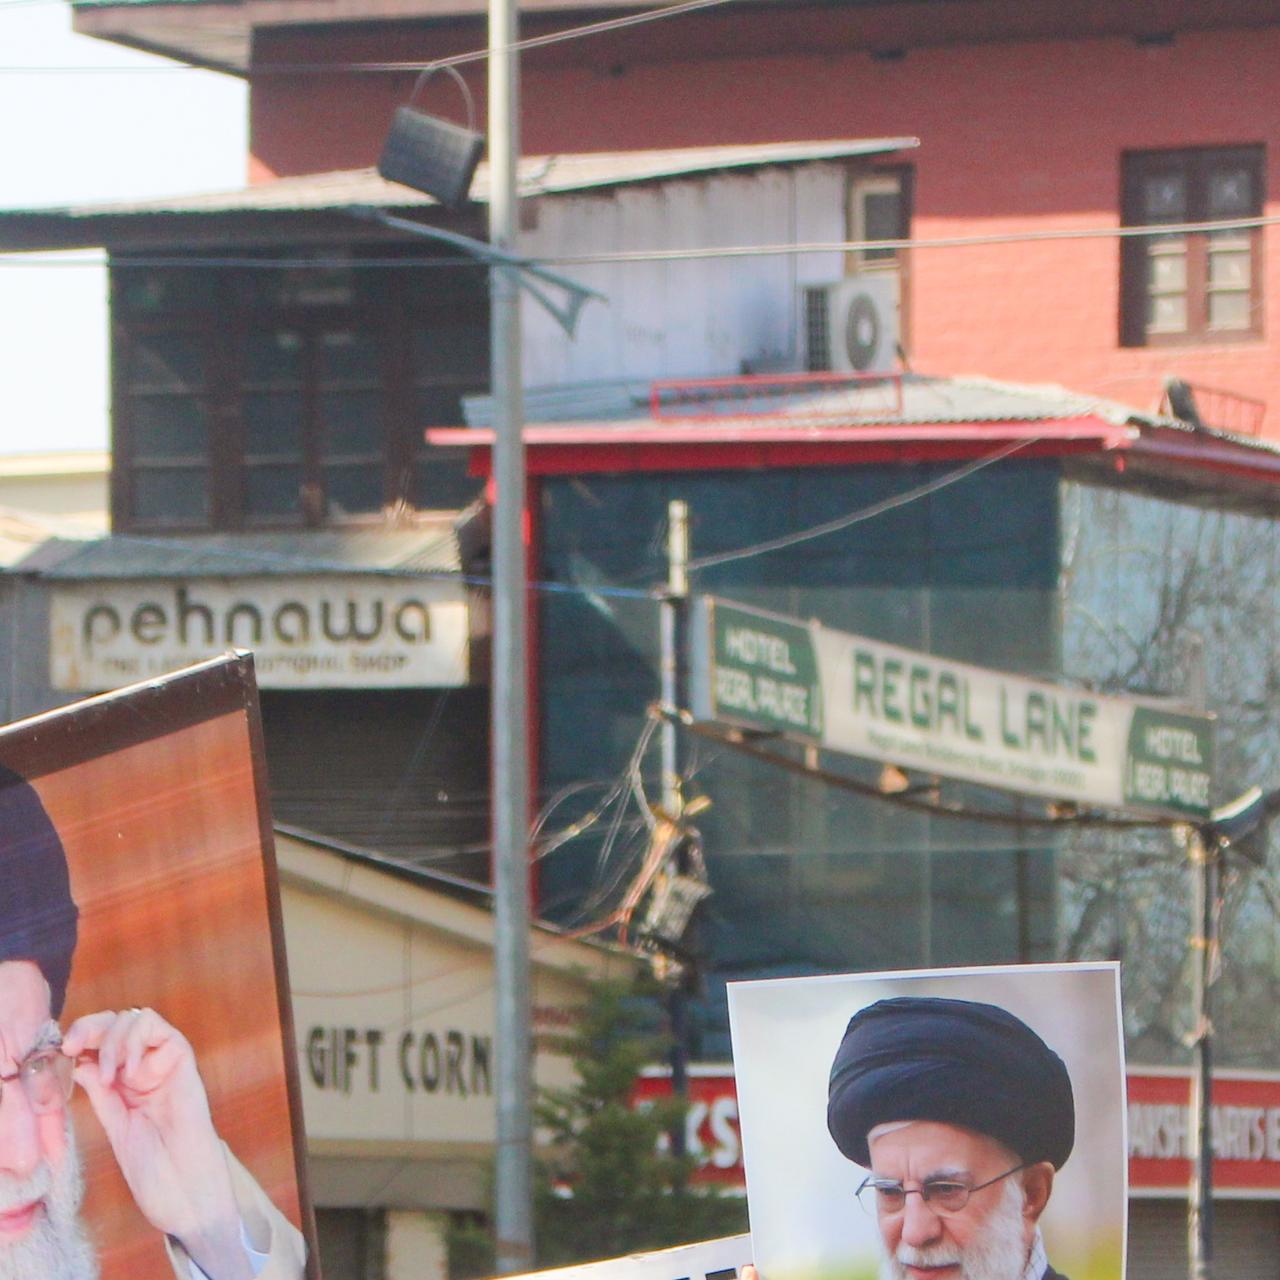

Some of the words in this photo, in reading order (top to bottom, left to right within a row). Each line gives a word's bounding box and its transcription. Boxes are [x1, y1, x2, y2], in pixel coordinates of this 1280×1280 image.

[83, 587, 432, 657] pehnawa
[724, 625, 798, 675] HOTEL
[854, 650, 985, 741] REGAL
[999, 683, 1098, 764] LANE
[1145, 724, 1203, 764] HOTEL
[307, 1026, 386, 1094] GIFT
